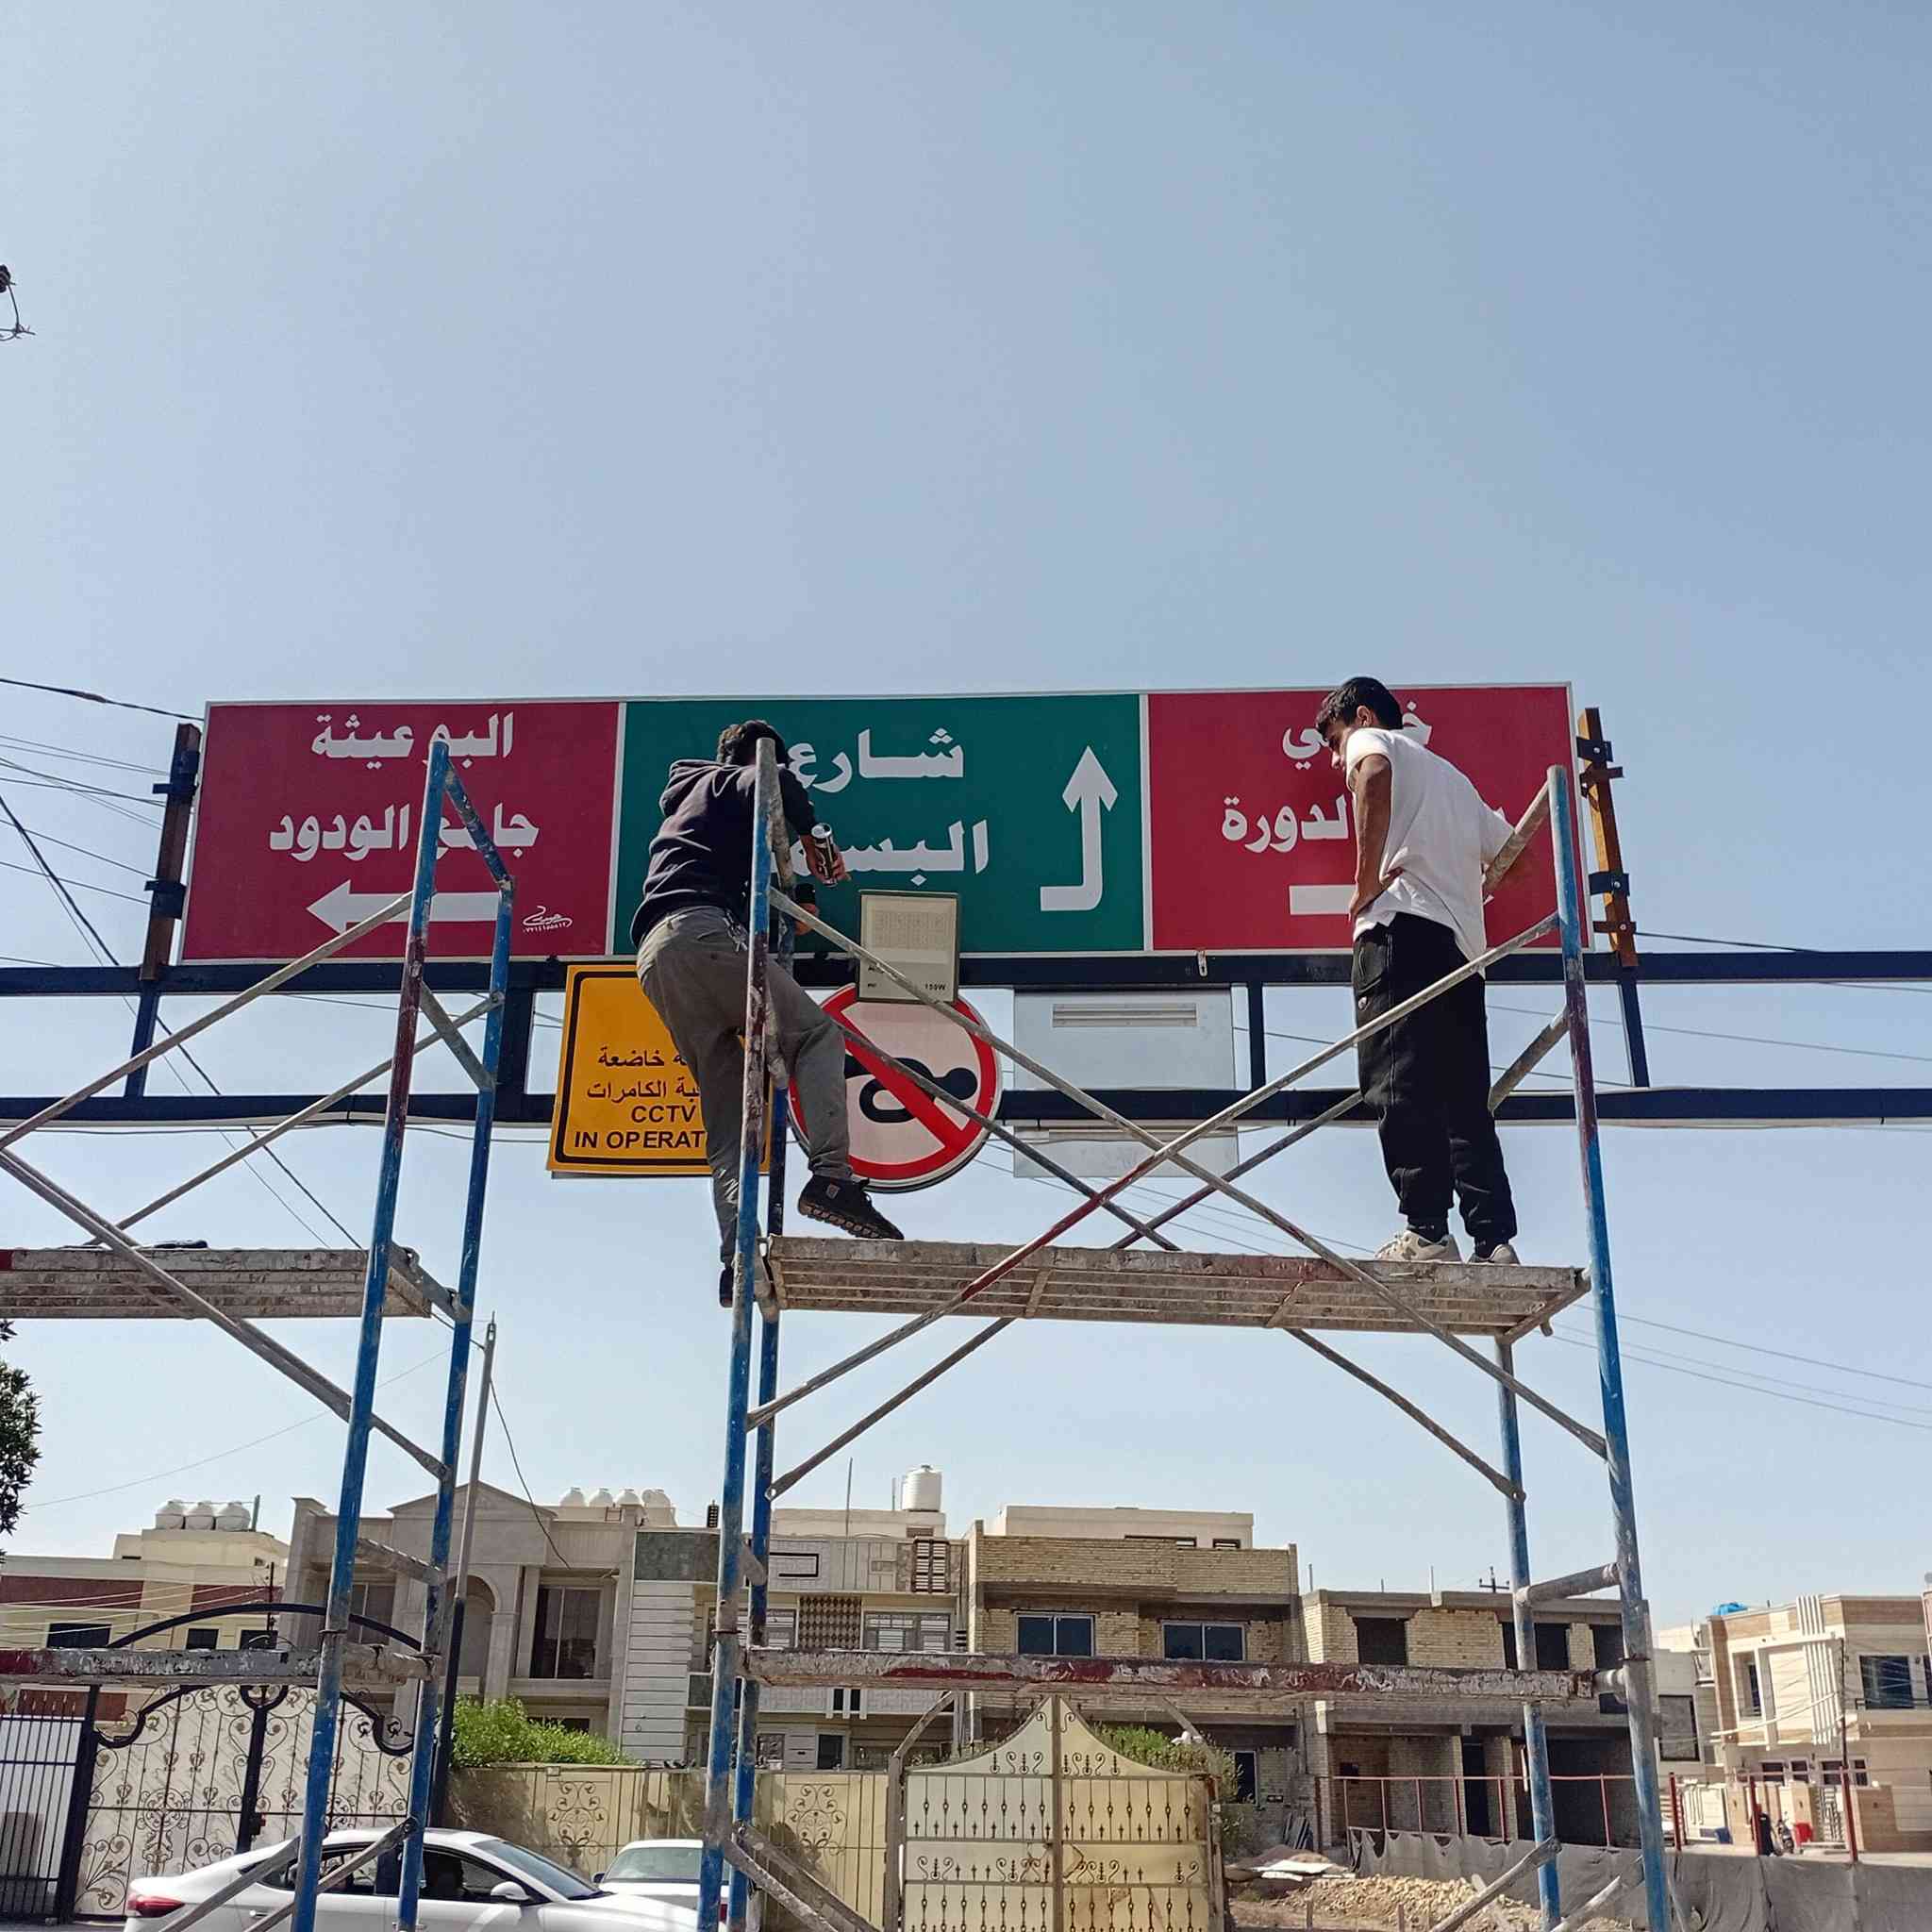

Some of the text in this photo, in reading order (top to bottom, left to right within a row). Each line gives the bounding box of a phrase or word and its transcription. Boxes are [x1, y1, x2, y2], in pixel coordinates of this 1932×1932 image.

[311, 713, 415, 770] عيثة
[785, 727, 964, 793] شارع
[270, 803, 409, 862] الودود
[597, 1046, 665, 1067] خاضعة
[630, 1105, 696, 1124] CCTV
[574, 1130, 706, 1149] IN OPERAT
